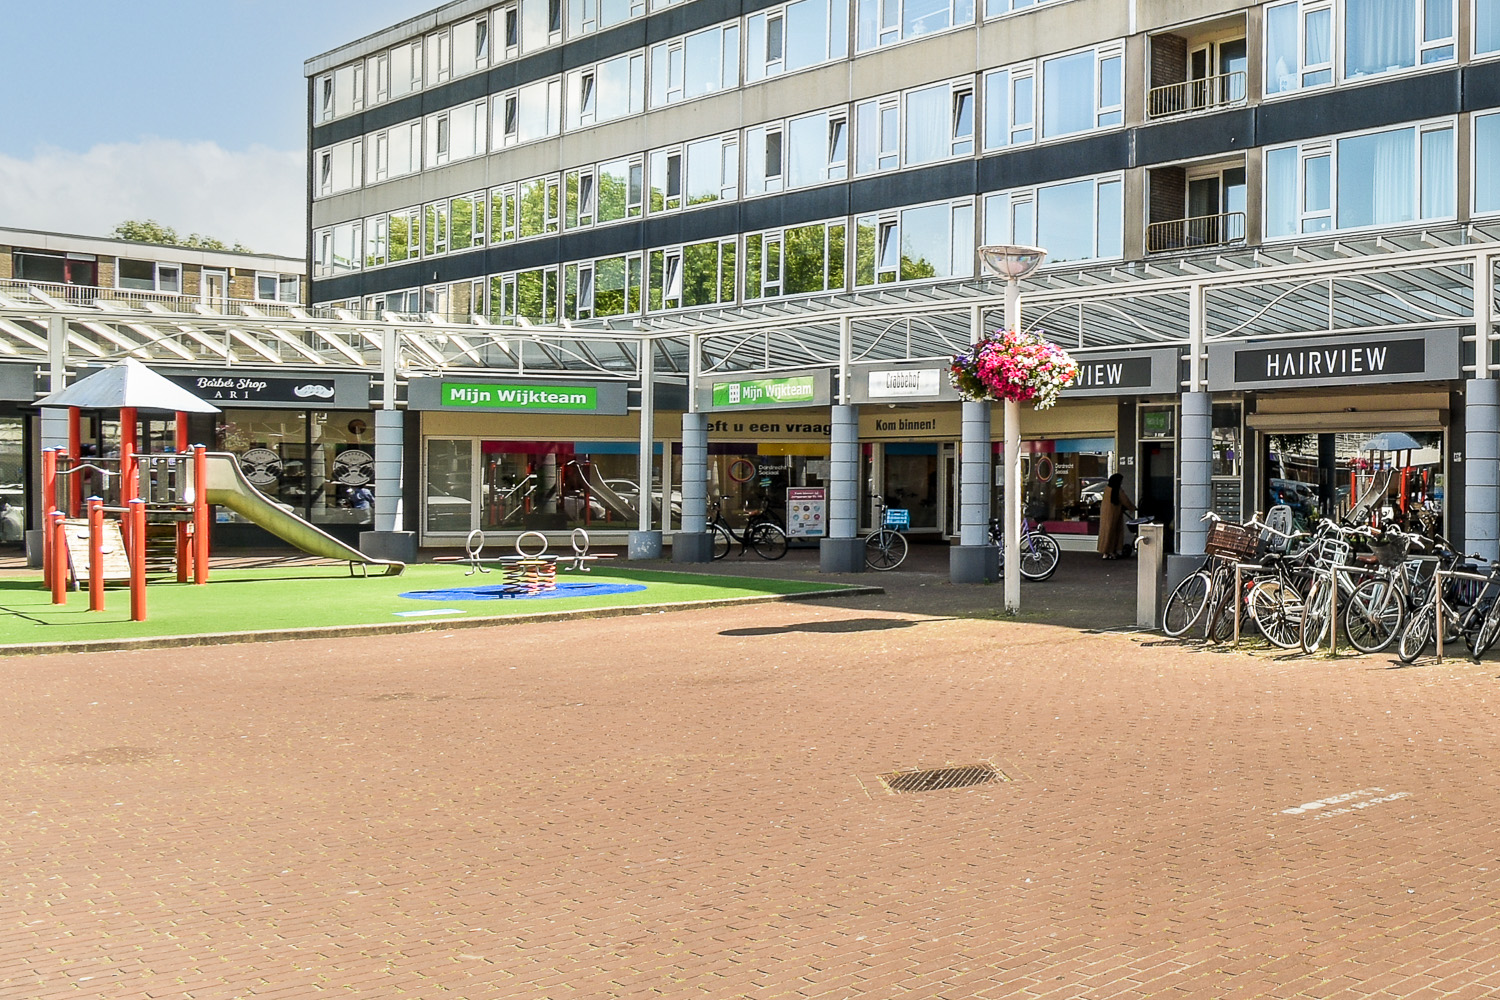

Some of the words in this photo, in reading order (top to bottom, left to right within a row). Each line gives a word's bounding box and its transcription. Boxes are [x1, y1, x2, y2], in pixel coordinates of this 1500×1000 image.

[1266, 346, 1387, 377] HAIRVIEW
[886, 371, 921, 390] Crabbehof
[1076, 363, 1123, 386] VIEW
[197, 377, 234, 389] Barber
[236, 378, 267, 391] Shop
[743, 386, 763, 401] Mijn
[765, 384, 812, 399] Wijkteam
[450, 388, 491, 404] Mijn
[497, 390, 587, 405] Wijkteam
[707, 420, 728, 432] eft
[733, 423, 743, 432] u
[749, 423, 780, 432] een
[786, 424, 832, 436] vraag
[876, 419, 897, 431] Kom
[899, 418, 936, 431] binnen!
